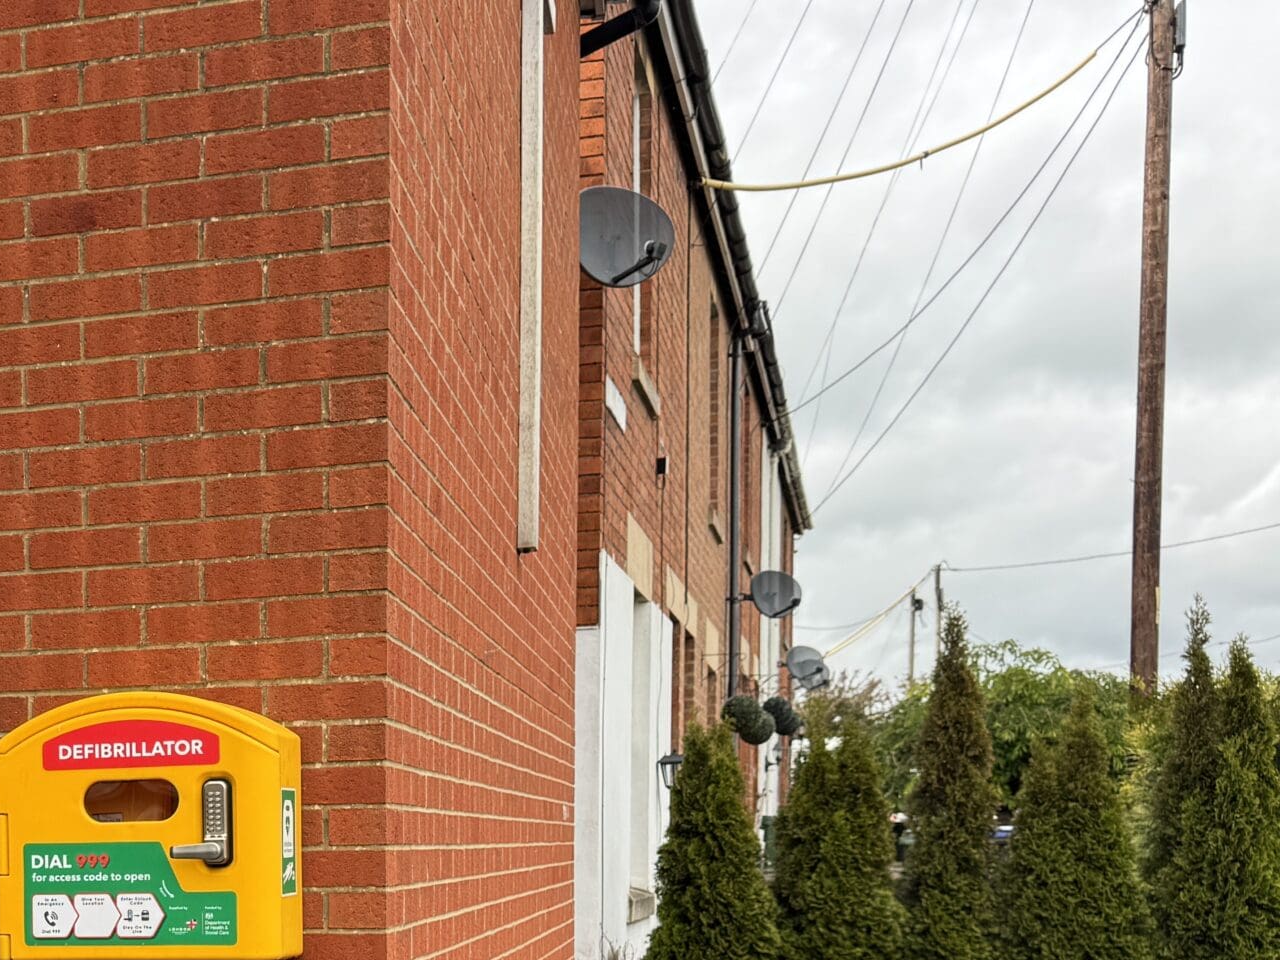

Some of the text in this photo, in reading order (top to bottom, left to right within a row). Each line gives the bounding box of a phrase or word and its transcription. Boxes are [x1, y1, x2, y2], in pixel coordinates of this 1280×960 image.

[58, 739, 203, 760] DEFIBRILLATOR
[31, 854, 110, 869] DIAL 999
[32, 872, 151, 883] for access code to open
